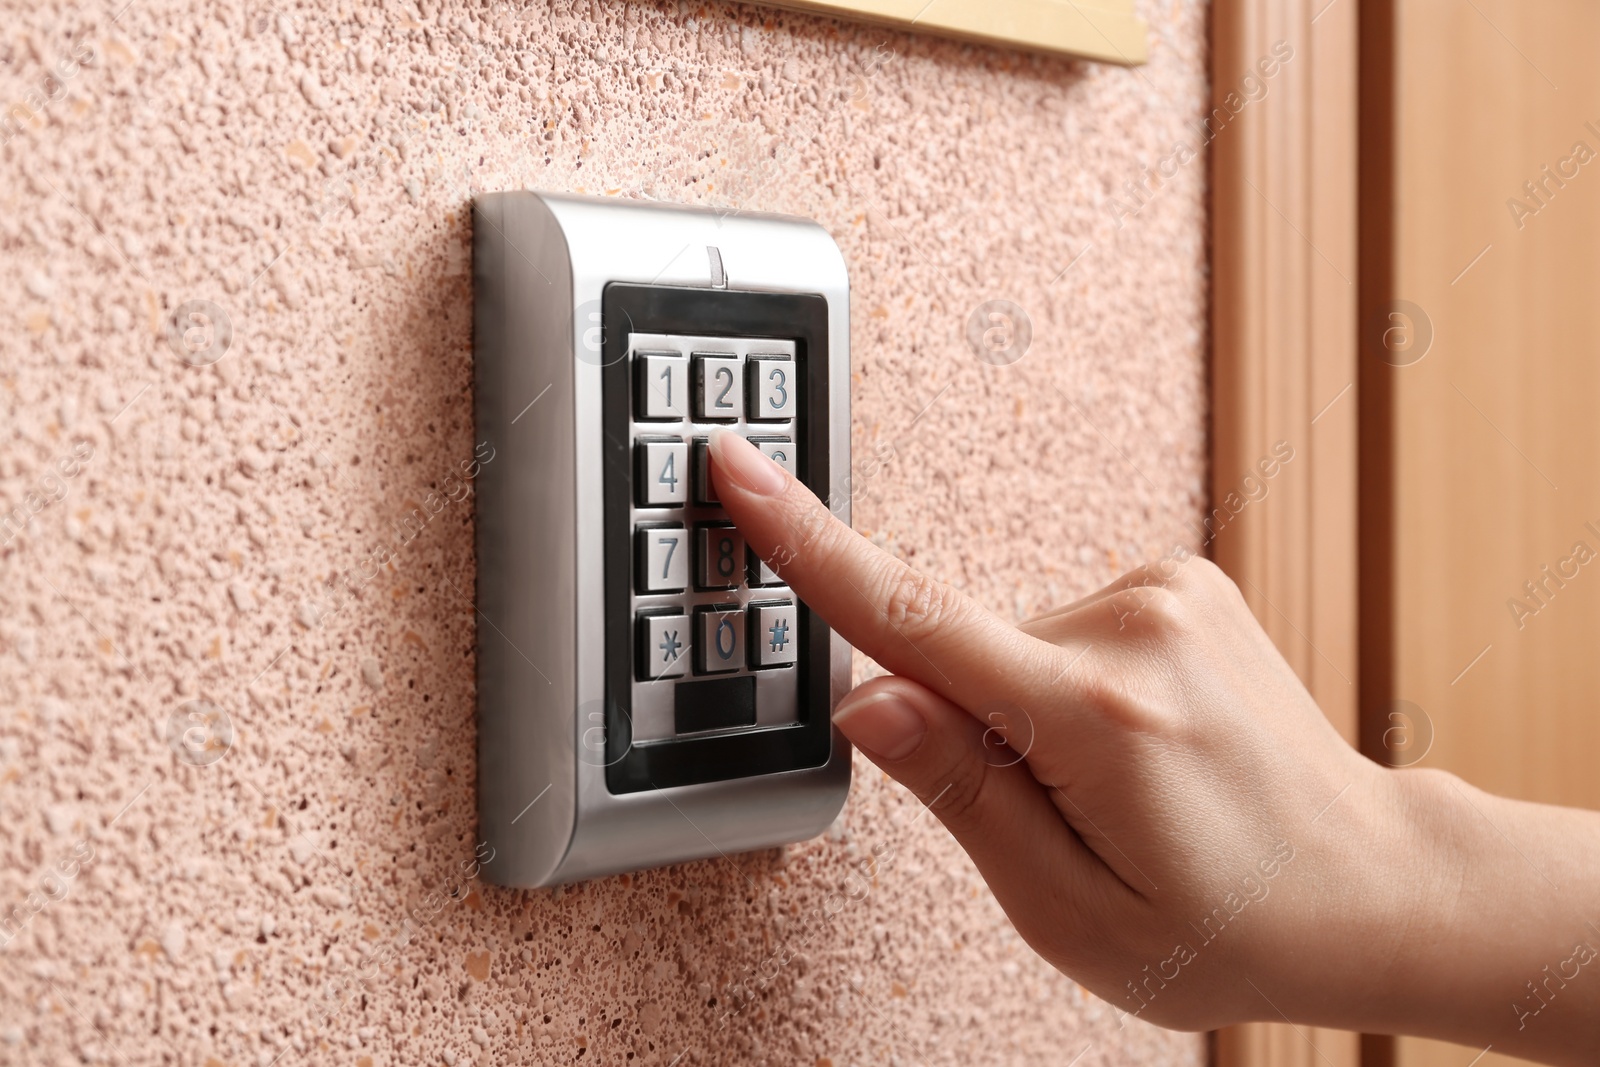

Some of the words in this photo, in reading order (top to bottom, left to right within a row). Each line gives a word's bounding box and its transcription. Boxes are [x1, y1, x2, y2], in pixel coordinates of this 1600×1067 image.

[660, 365, 672, 408] 1
[714, 366, 734, 408] 2
[768, 368, 788, 409] 3
[658, 452, 678, 493] 4
[658, 537, 678, 579] 7
[717, 537, 736, 578] 8
[716, 618, 736, 660] 0
